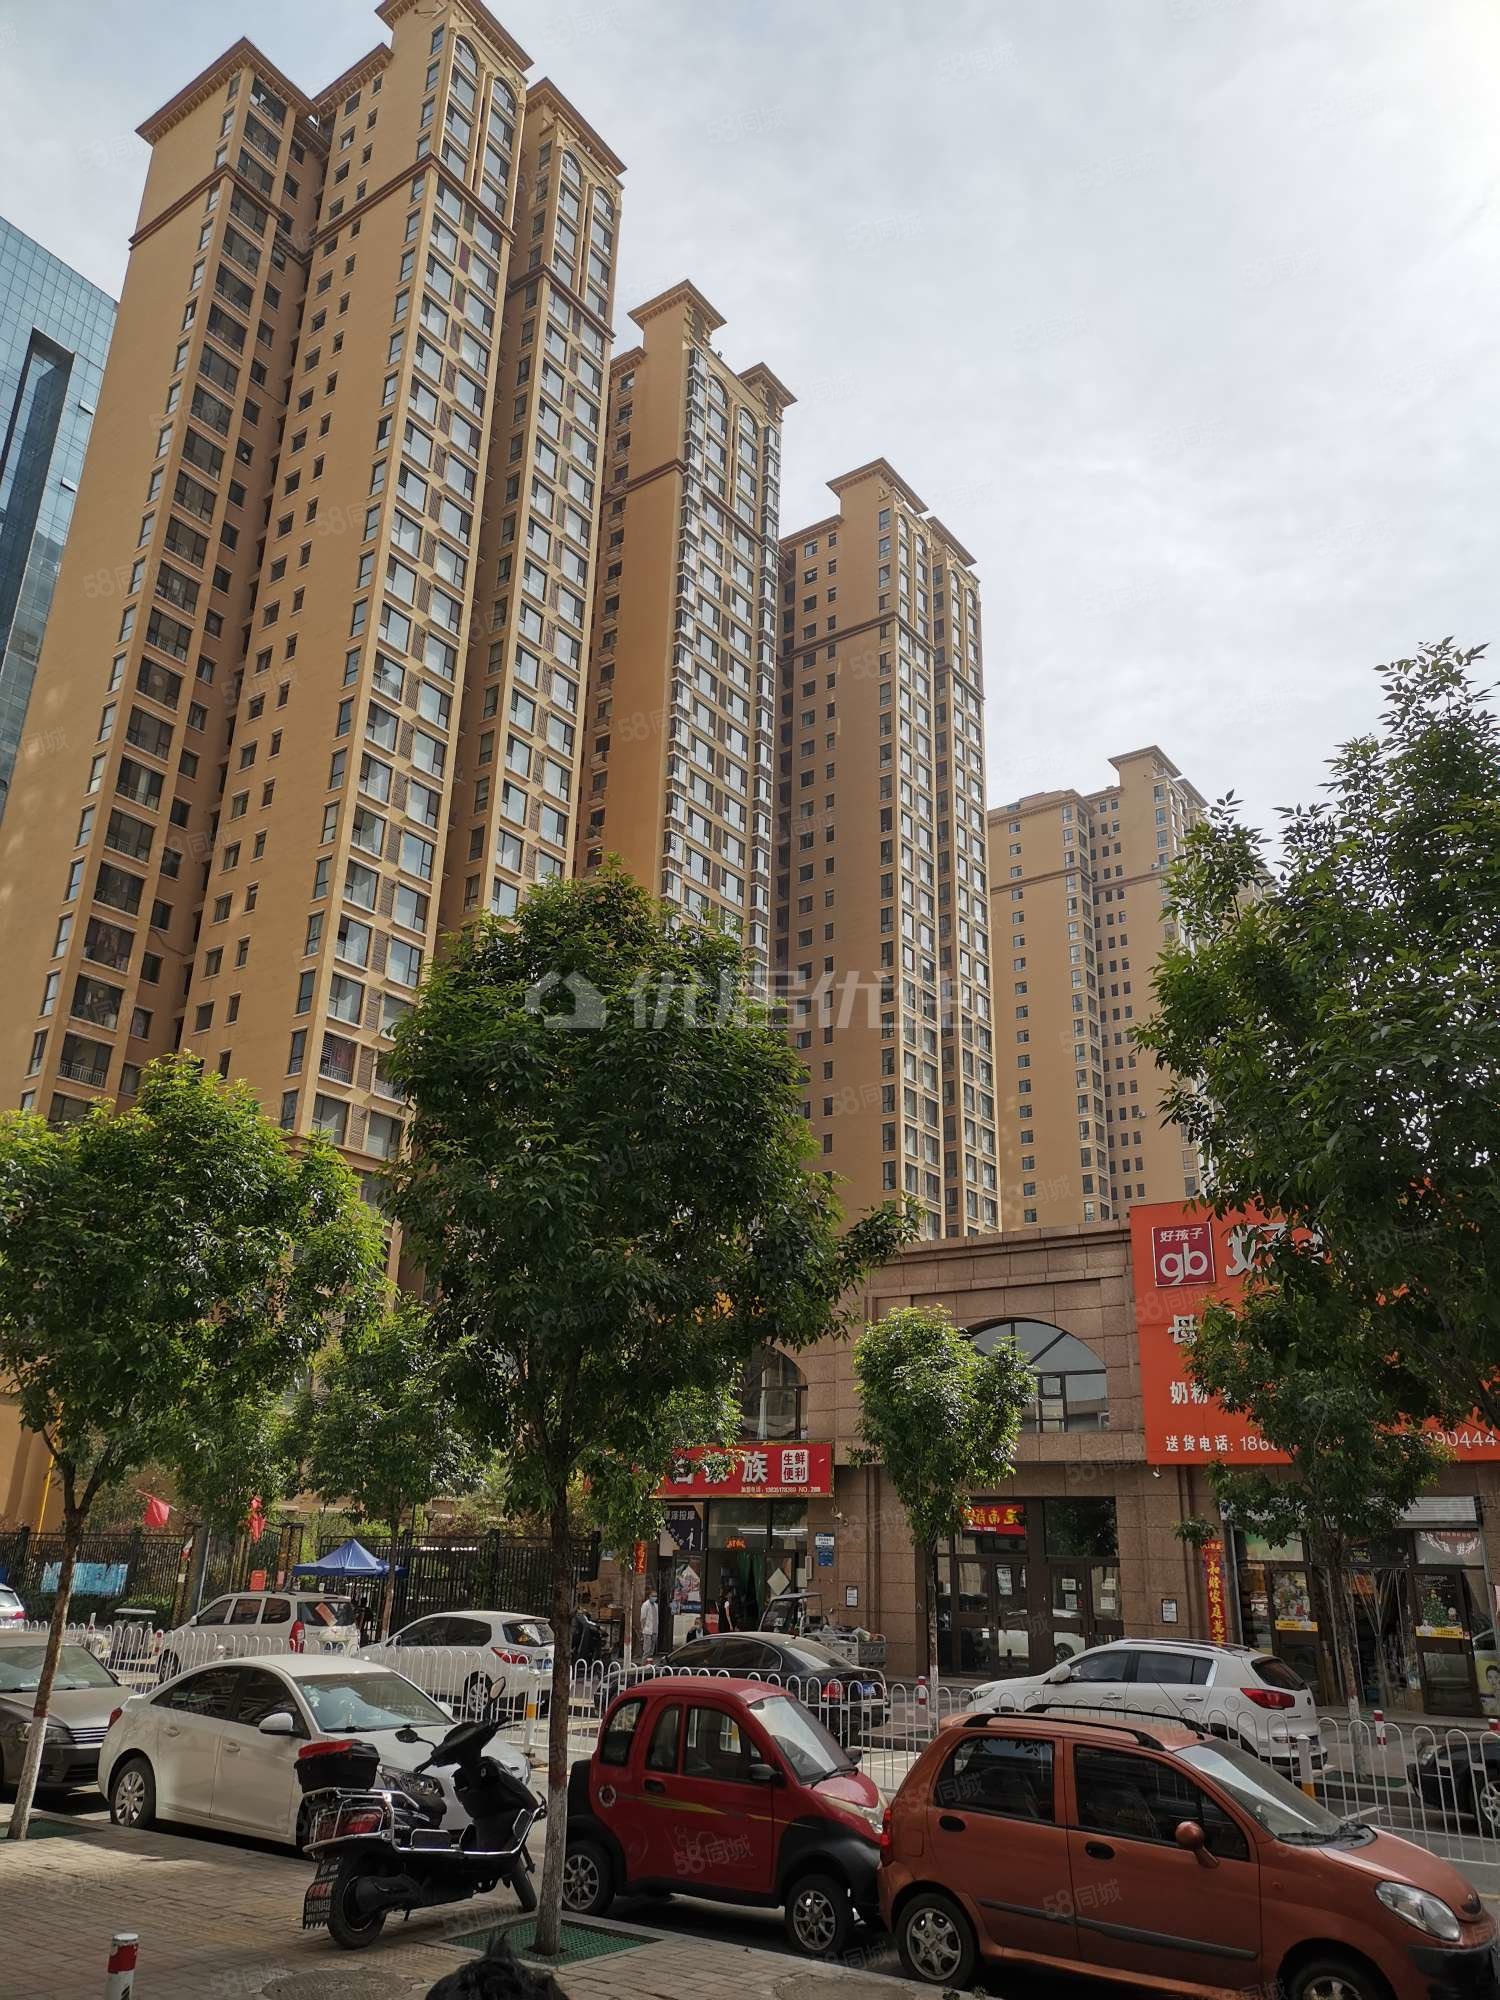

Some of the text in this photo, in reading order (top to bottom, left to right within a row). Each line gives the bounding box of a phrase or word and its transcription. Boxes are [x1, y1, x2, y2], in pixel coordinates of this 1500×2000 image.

[1160, 1228, 1203, 1242] 好孩子
[1160, 1243, 1207, 1284] gb
[783, 1452, 806, 1465] 生鲜
[783, 1467, 806, 1481] 便利
